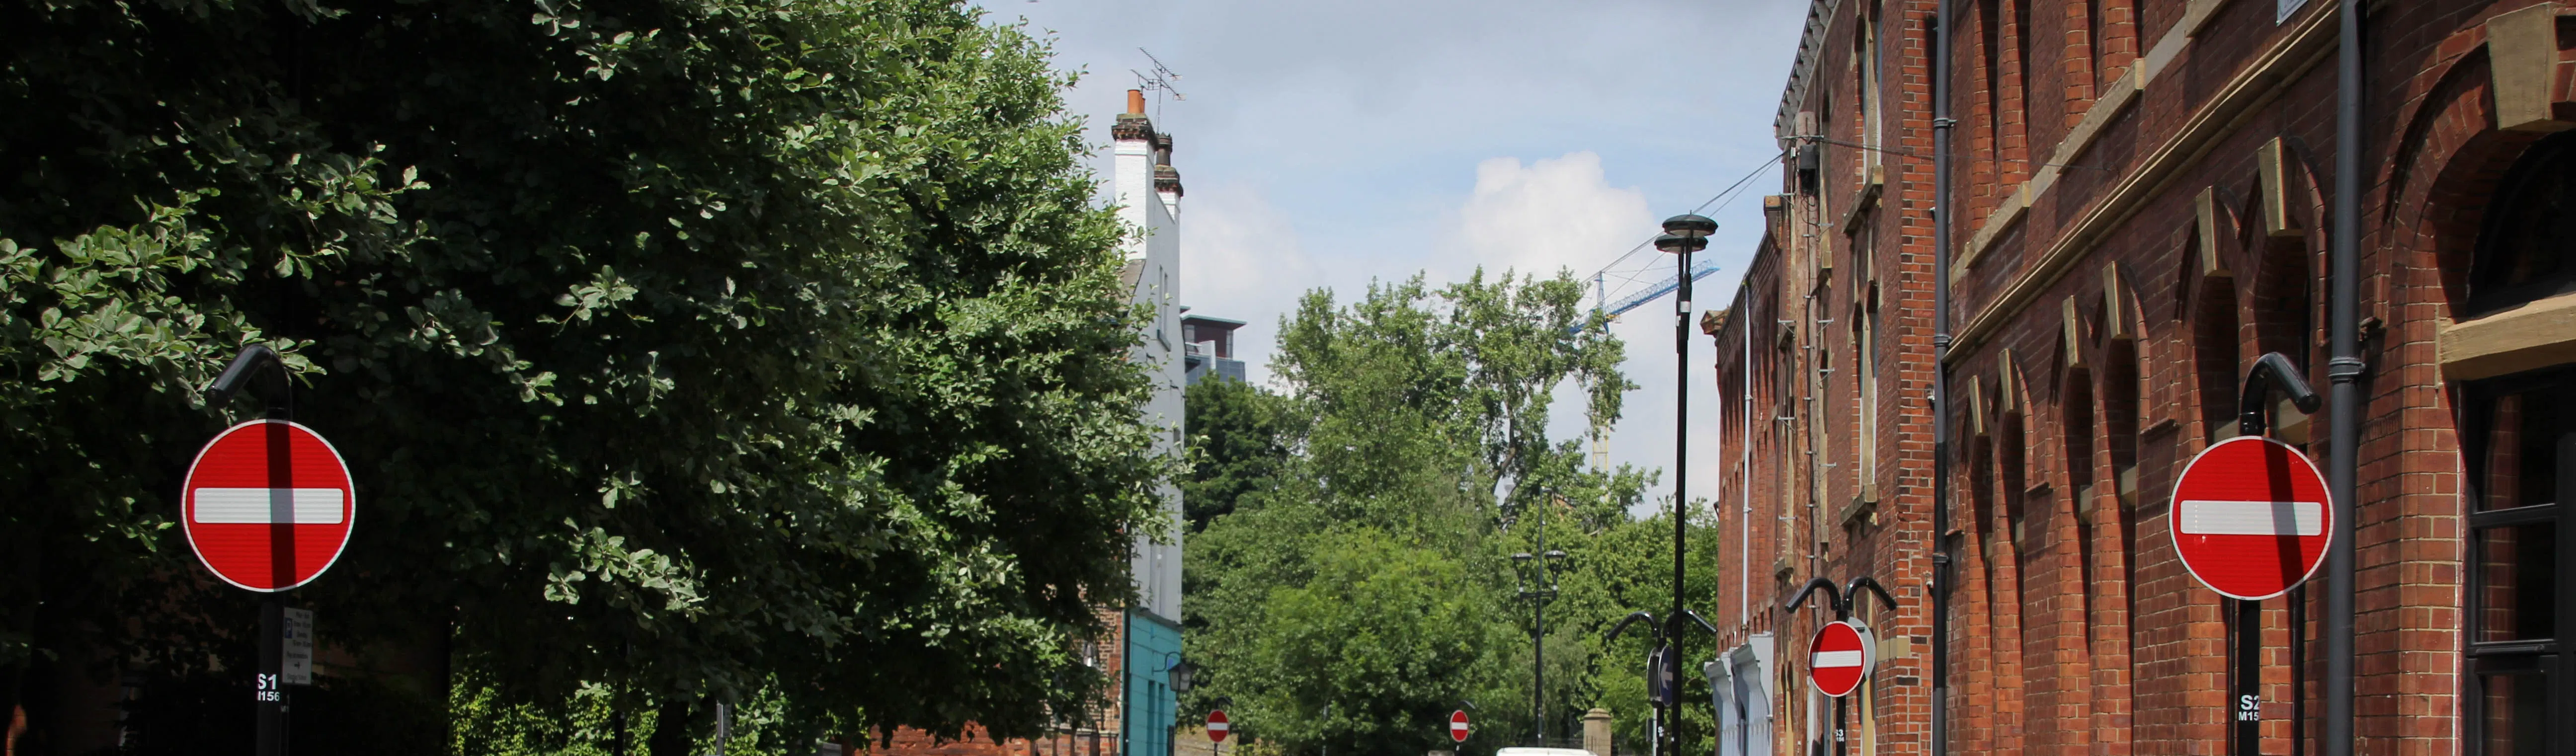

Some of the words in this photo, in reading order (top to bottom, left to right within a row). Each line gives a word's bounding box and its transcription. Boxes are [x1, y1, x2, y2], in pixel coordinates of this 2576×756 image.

[258, 673, 276, 689] S1
[257, 691, 280, 701] 156
[2241, 694, 2259, 710] S2
[2238, 711, 2259, 721] M15
